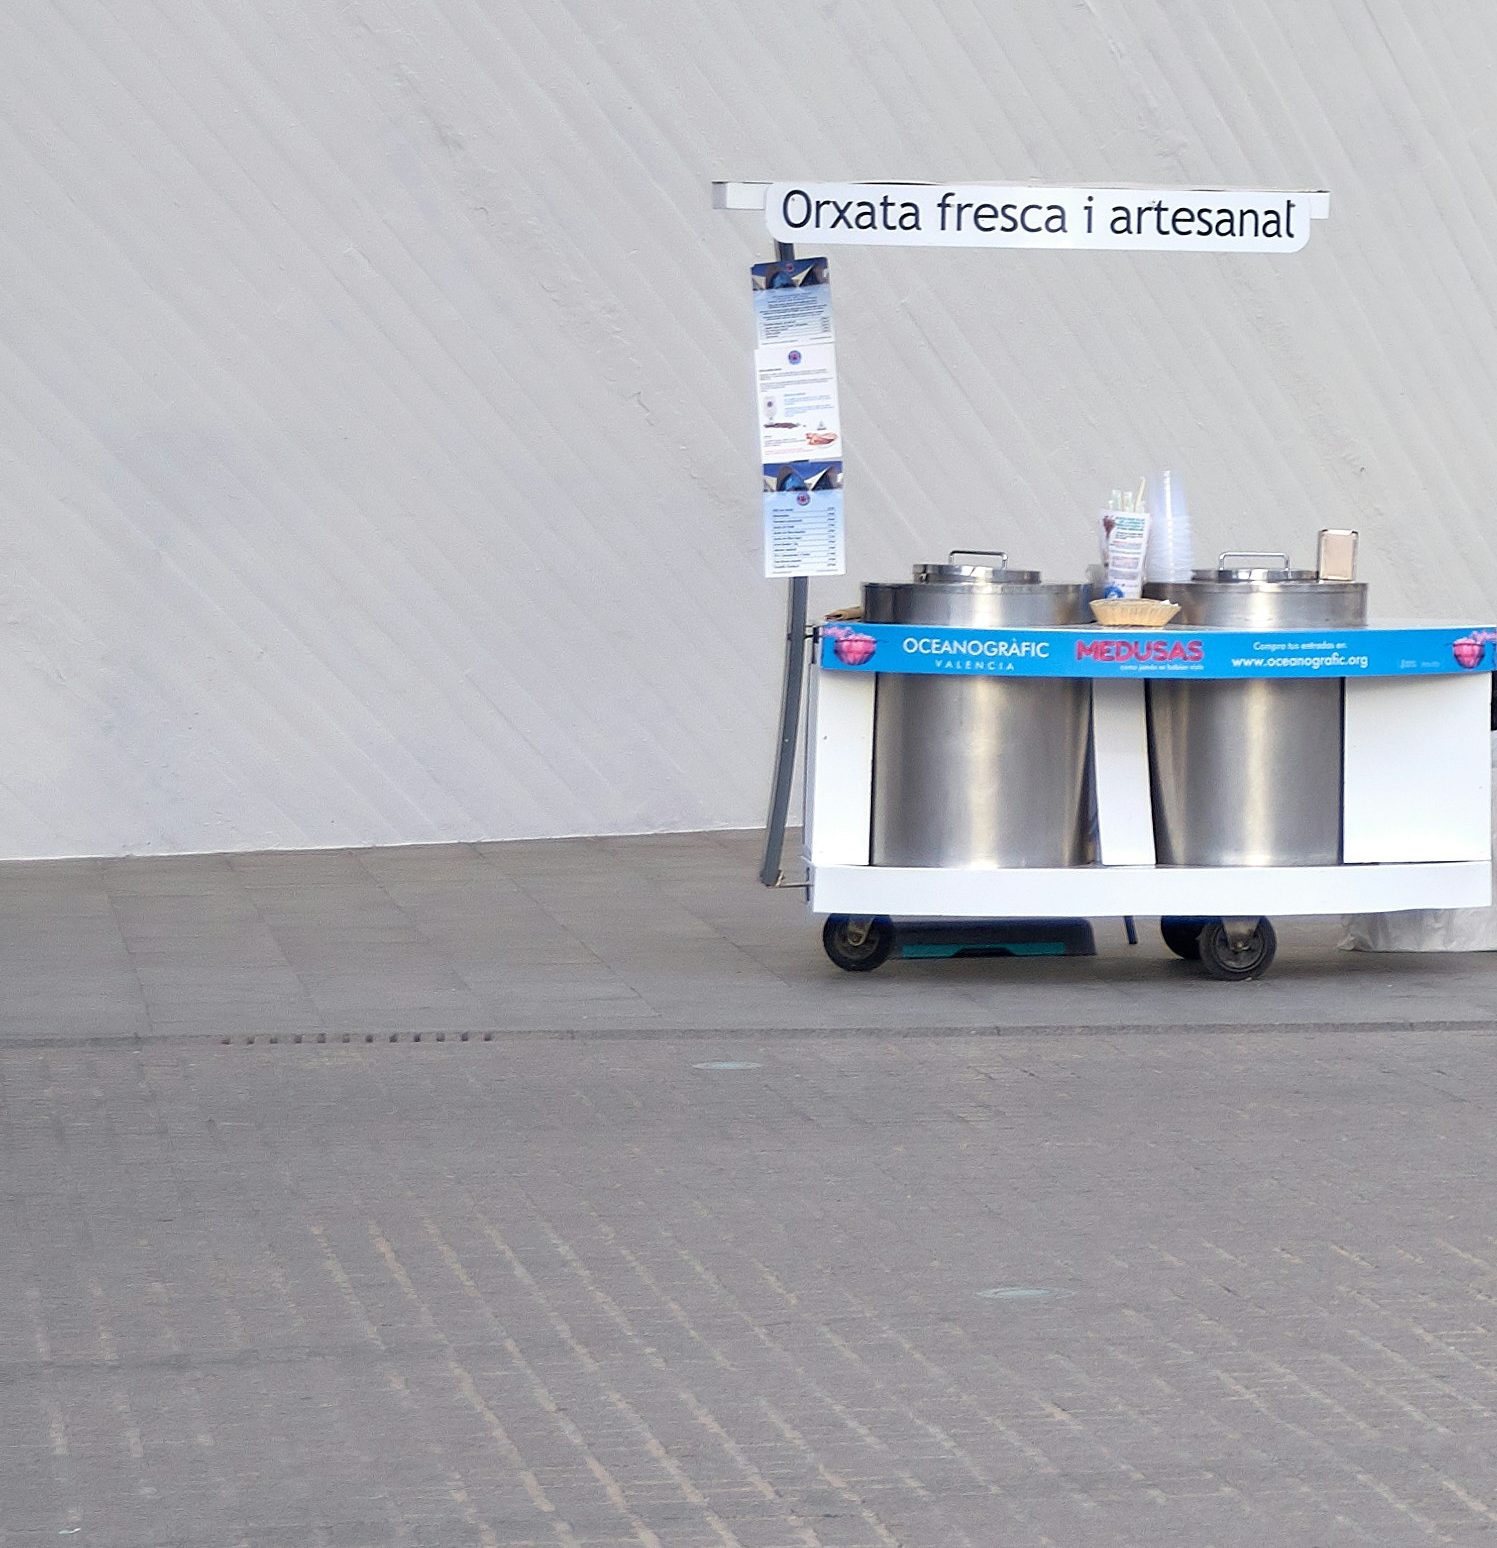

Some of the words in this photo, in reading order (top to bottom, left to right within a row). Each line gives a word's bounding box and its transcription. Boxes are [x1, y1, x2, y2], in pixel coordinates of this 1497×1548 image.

[782, 189, 921, 231] Orxata
[937, 192, 1067, 233] fresca
[1083, 195, 1094, 234] i
[1110, 199, 1295, 238] artesanal
[902, 637, 1050, 658] OCEANOGRÀFIC
[1076, 639, 1205, 663] MEDUSAS
[935, 659, 1015, 671] VALENCIA
[1231, 651, 1369, 669] www.oceanografic.org
